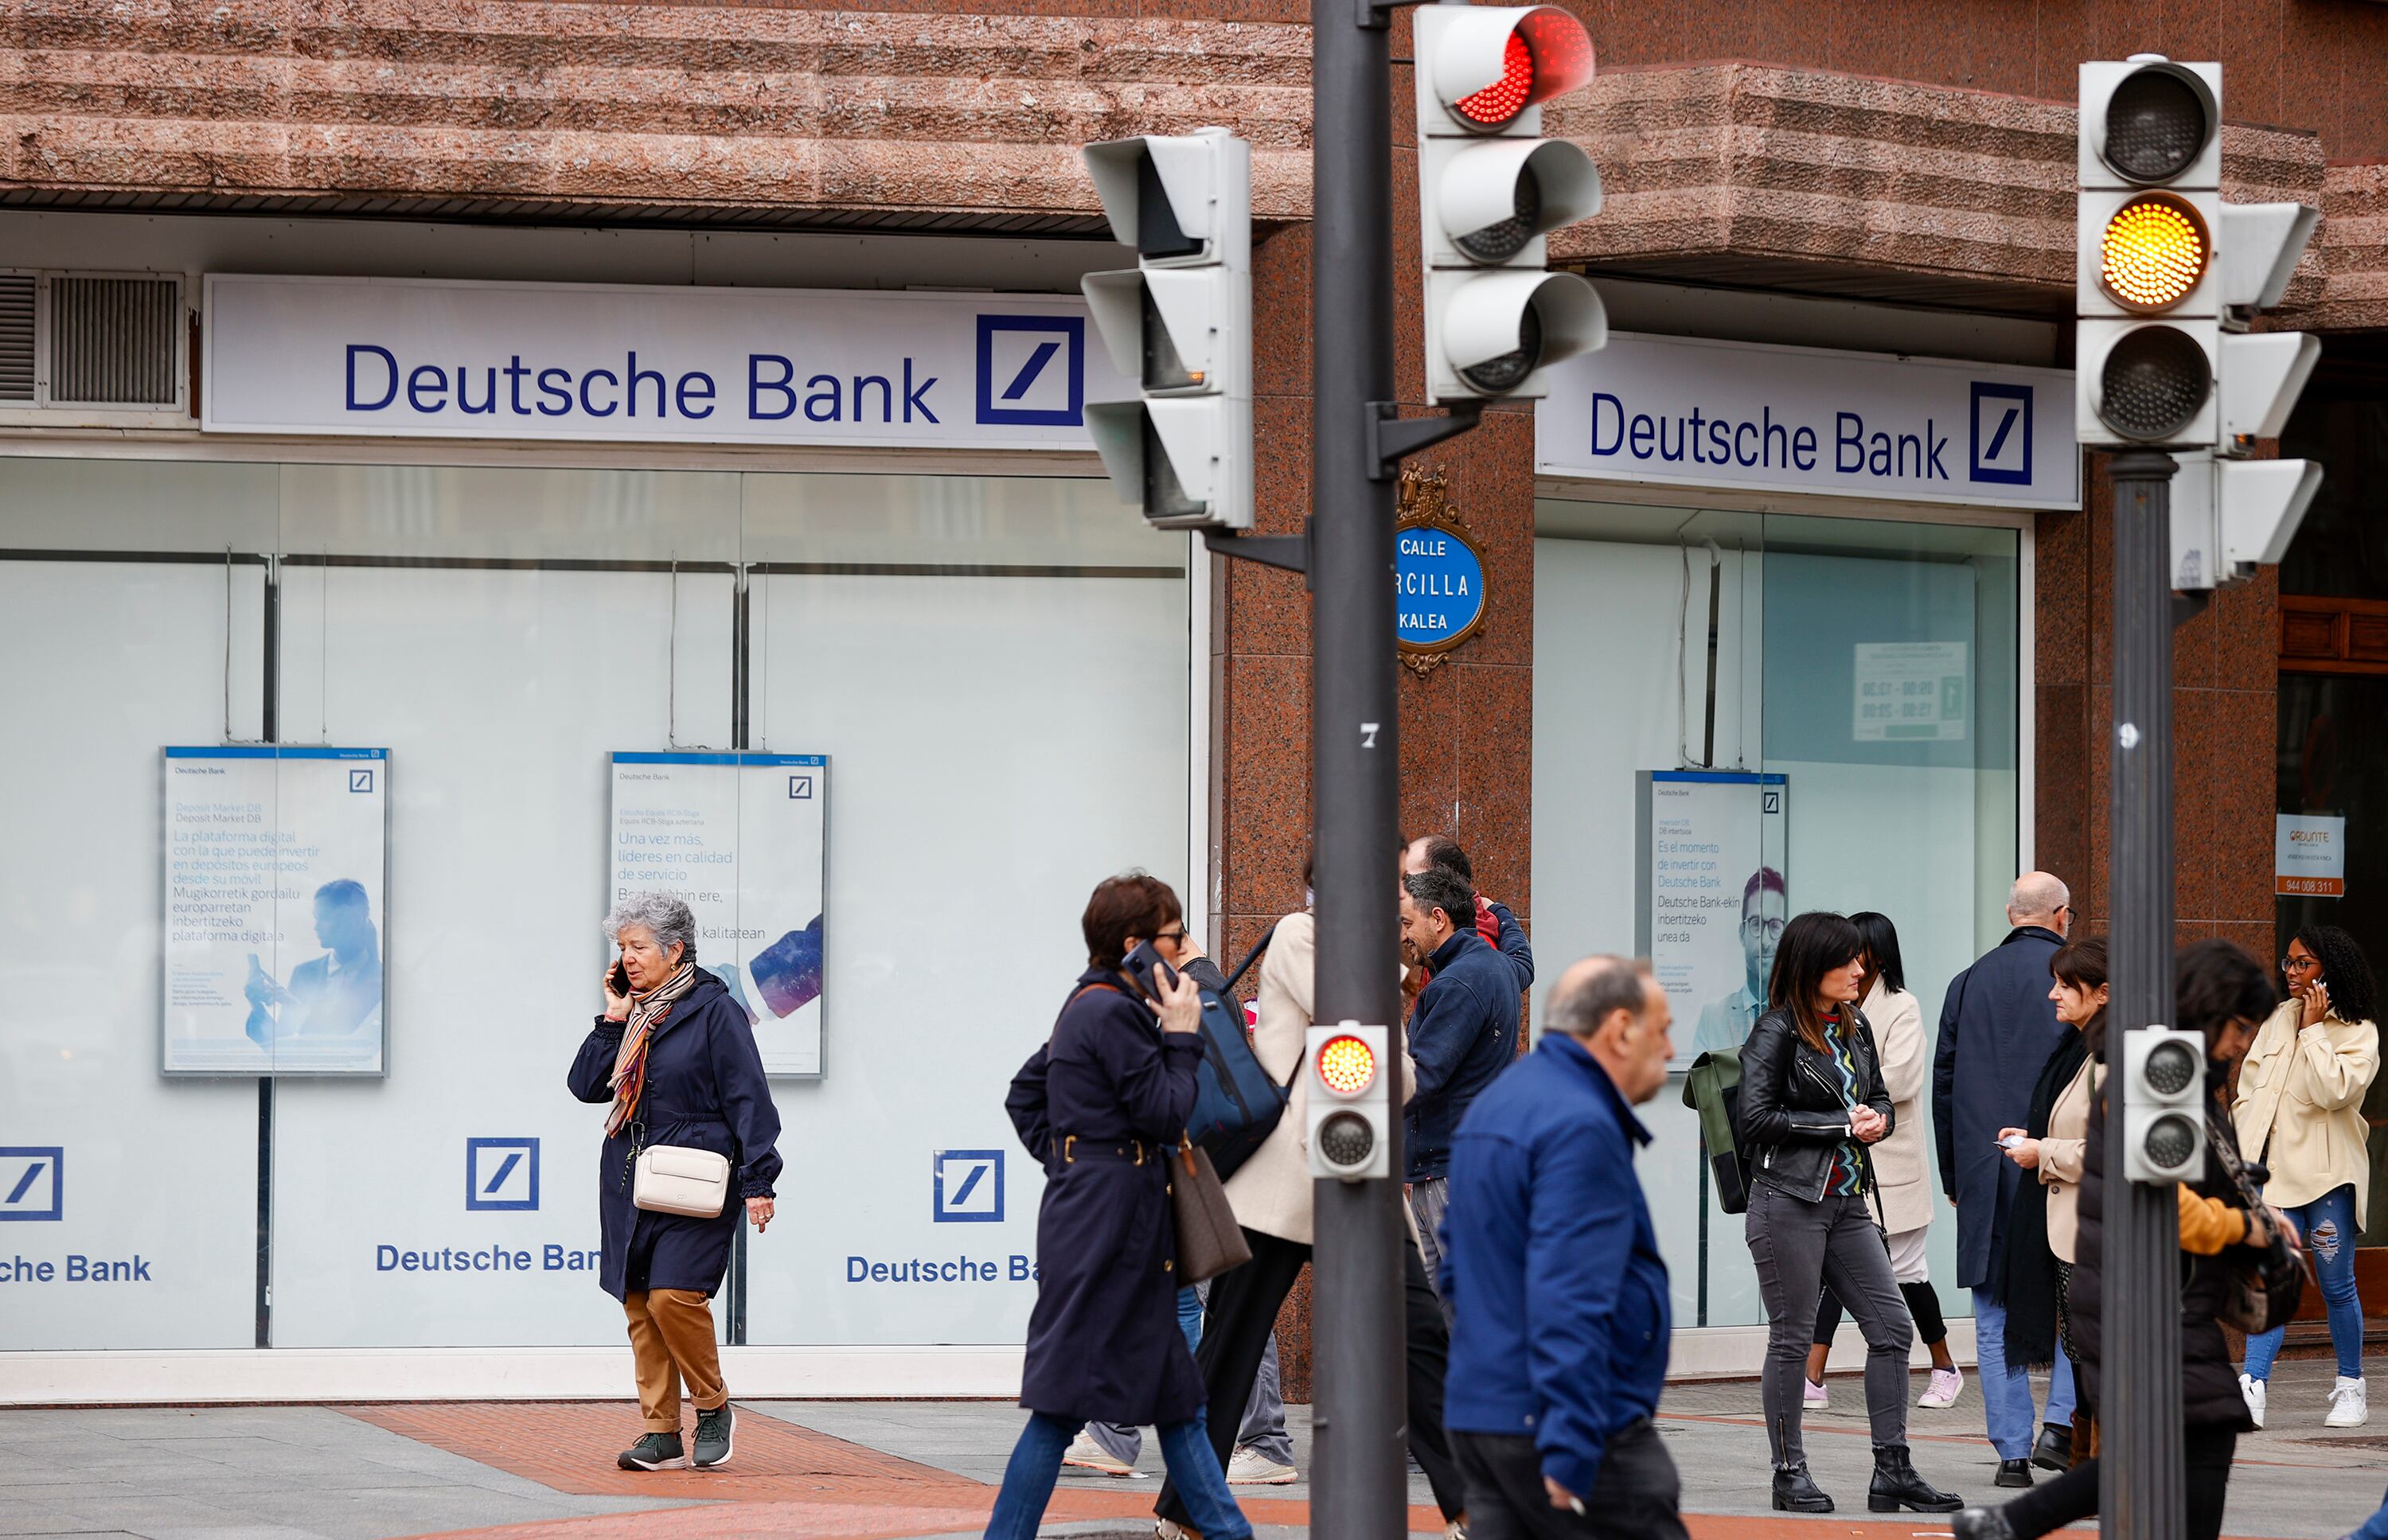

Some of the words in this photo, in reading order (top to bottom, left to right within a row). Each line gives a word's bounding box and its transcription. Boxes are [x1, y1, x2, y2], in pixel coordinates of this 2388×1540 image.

[345, 344, 716, 419] Deutsche
[748, 354, 940, 424] Bank
[1592, 392, 1817, 471] Deutsche
[1836, 411, 1949, 481] Bank
[1400, 539, 1446, 556] CALLE
[1395, 572, 1469, 596] RCILLA
[1399, 613, 1447, 630] KALEA
[1360, 723, 1380, 748] 7
[175, 803, 211, 815] Deposit
[213, 803, 244, 813] Market
[248, 804, 262, 813] DB
[176, 813, 211, 825] Deposit
[213, 813, 244, 823] Market
[248, 814, 262, 823] DB
[174, 830, 189, 843] La
[191, 830, 257, 845] plataforma
[259, 831, 296, 846] digital
[618, 832, 646, 844] Una
[649, 835, 670, 844] vez
[674, 832, 704, 846] más,
[173, 847, 196, 856] con
[198, 845, 209, 856] la
[213, 847, 235, 860] que
[238, 846, 275, 860] puede
[278, 845, 320, 858] invertir
[1658, 840, 1668, 852] Es
[1670, 841, 1678, 853] el
[1680, 843, 1719, 854] momento
[618, 849, 662, 863] líderes
[665, 852, 682, 863] en
[685, 852, 732, 864] calidad
[173, 861, 189, 870] en
[252, 862, 308, 873] europeos
[1658, 858, 1668, 870] de
[1670, 859, 1699, 871] invertir
[1701, 861, 1716, 871] con
[173, 874, 209, 885] desde
[213, 876, 227, 885] su
[618, 867, 634, 880] de
[638, 868, 688, 880] servicio
[1658, 875, 1698, 887] Deutsche
[1699, 875, 1721, 888] Bank
[2286, 879, 2300, 891] 944
[2301, 880, 2316, 892] 008
[2317, 880, 2332, 893] 311
[174, 887, 249, 901] Mugikorretik
[251, 888, 300, 902] gordailu
[699, 892, 723, 903] ere,
[1658, 895, 1698, 907] Deutsche
[1699, 895, 1740, 908] Bank-ekin
[173, 903, 252, 915] europarretan
[173, 915, 243, 927] inbertitzeko
[1657, 913, 1707, 925] inbertitzeko
[173, 930, 237, 943] plataforma
[702, 926, 765, 939] kalitatean
[1657, 933, 1677, 942] unea
[1679, 930, 1690, 942] da
[377, 1244, 532, 1272] Deutsche
[543, 1244, 602, 1271] Ban
[67, 1255, 151, 1282] Bank
[847, 1255, 997, 1282] Deutsche
